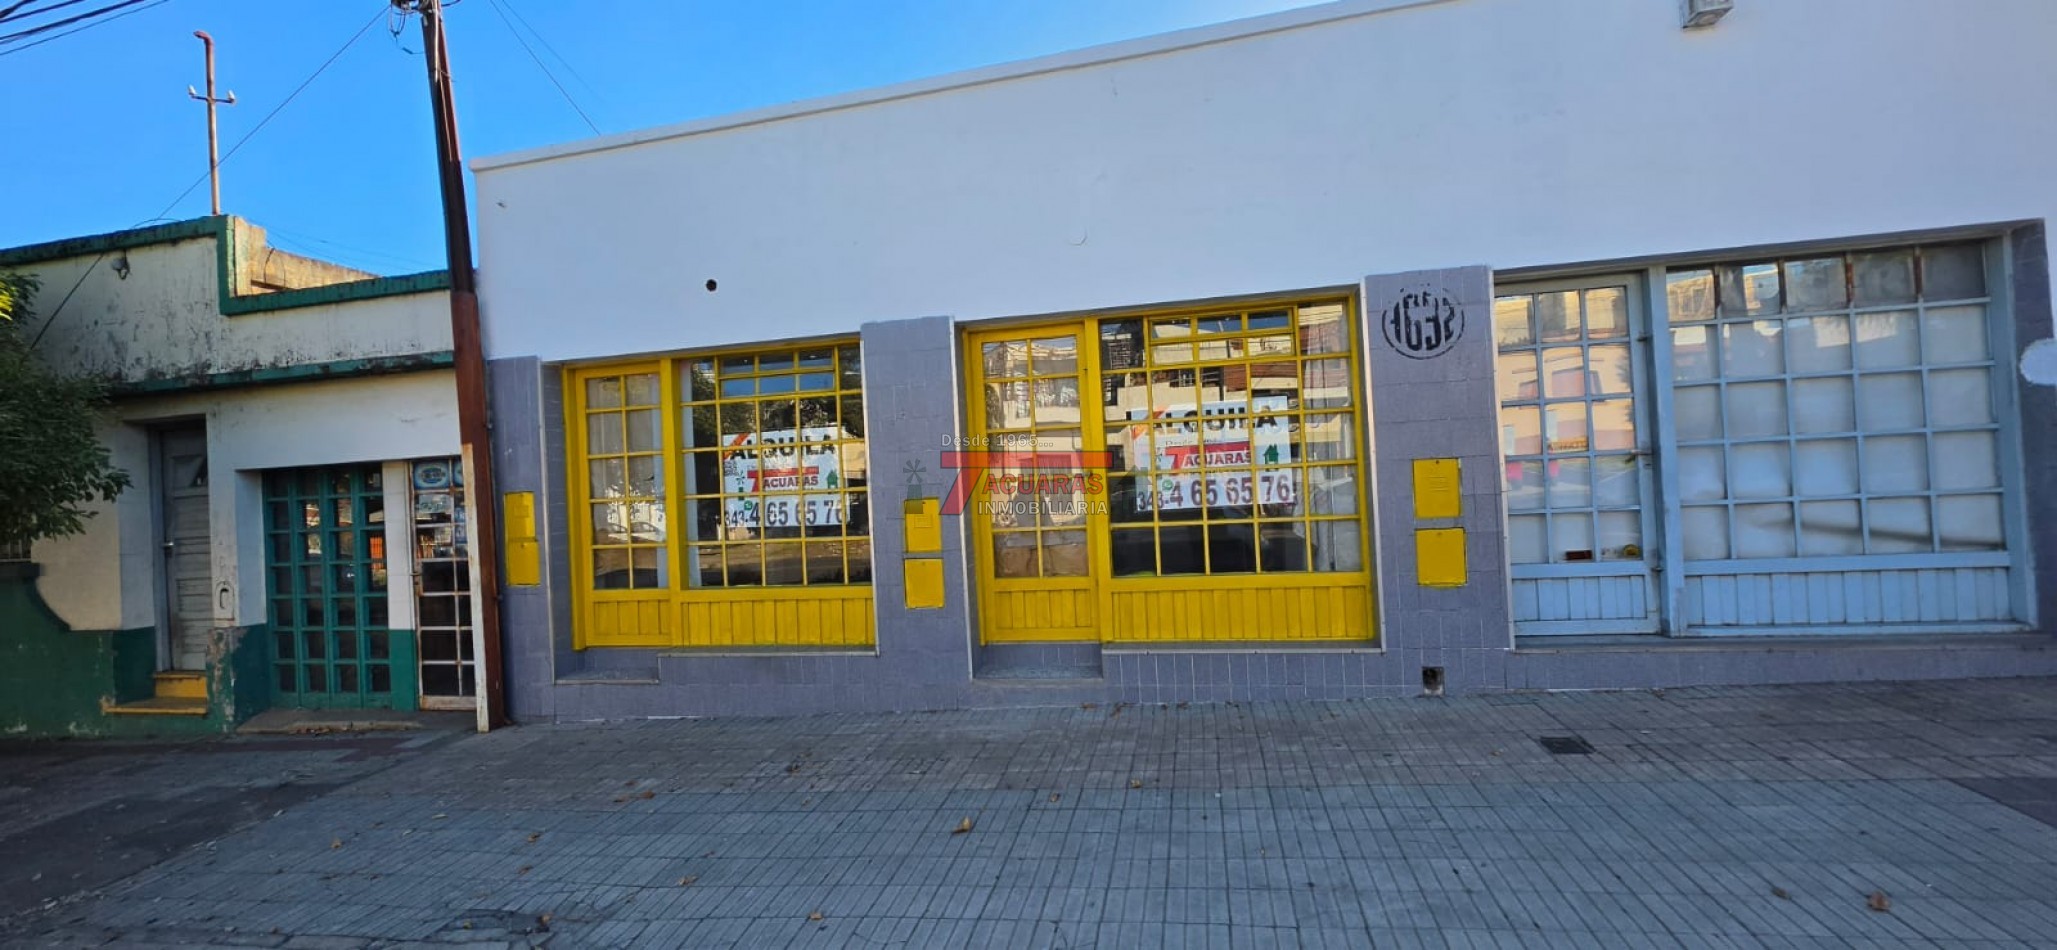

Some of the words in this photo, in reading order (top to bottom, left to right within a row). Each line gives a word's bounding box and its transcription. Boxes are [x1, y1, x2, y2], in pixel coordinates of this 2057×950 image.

[729, 434, 835, 460] ALQULA
[1191, 479, 1218, 506] 65
[1226, 477, 1253, 504] 65
[1261, 474, 1290, 503] 76
[767, 502, 789, 526] 65
